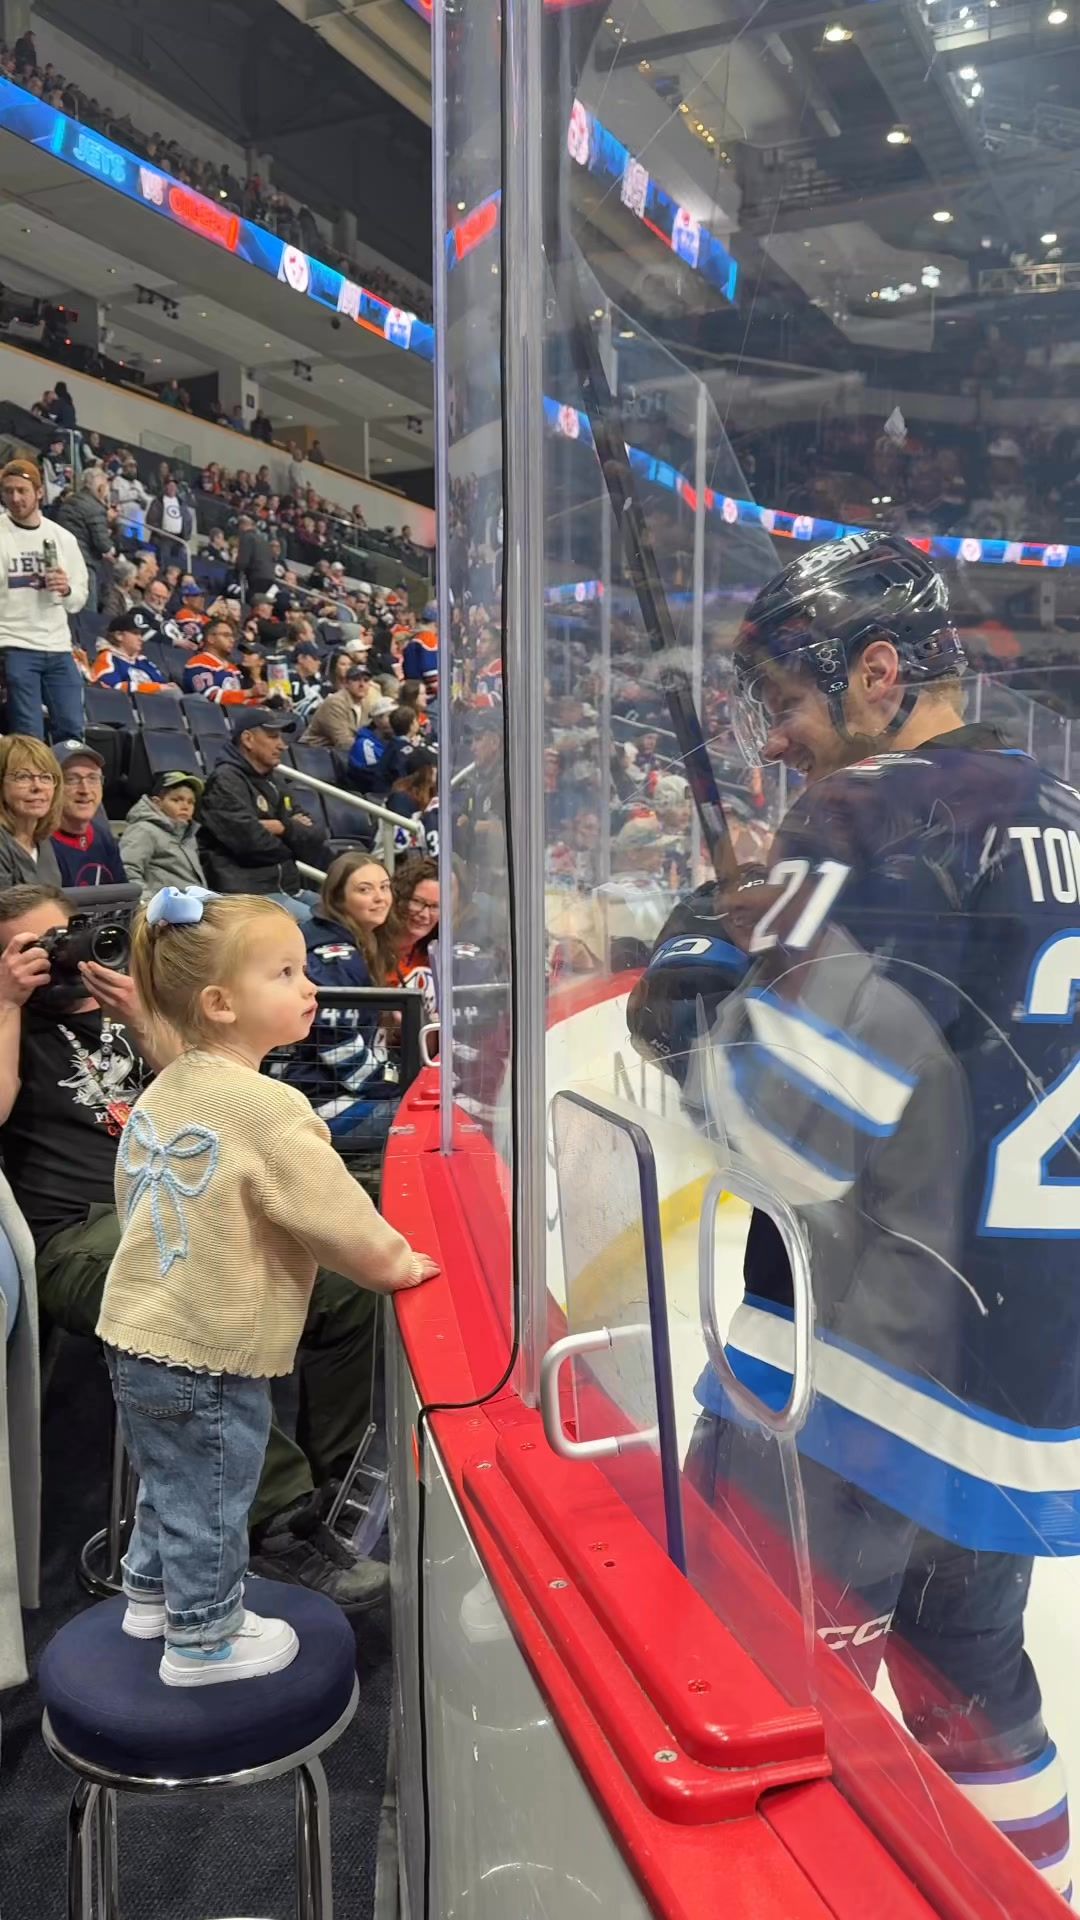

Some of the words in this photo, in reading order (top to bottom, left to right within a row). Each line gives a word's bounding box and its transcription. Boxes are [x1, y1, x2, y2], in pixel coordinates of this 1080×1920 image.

[73, 133, 126, 183] JETS
[8, 558, 47, 573] JET
[798, 534, 871, 578] Bell
[1008, 827, 1080, 903] TO
[748, 859, 850, 952] 21
[321, 1008, 359, 1027] 44
[817, 1613, 895, 1650] CC
